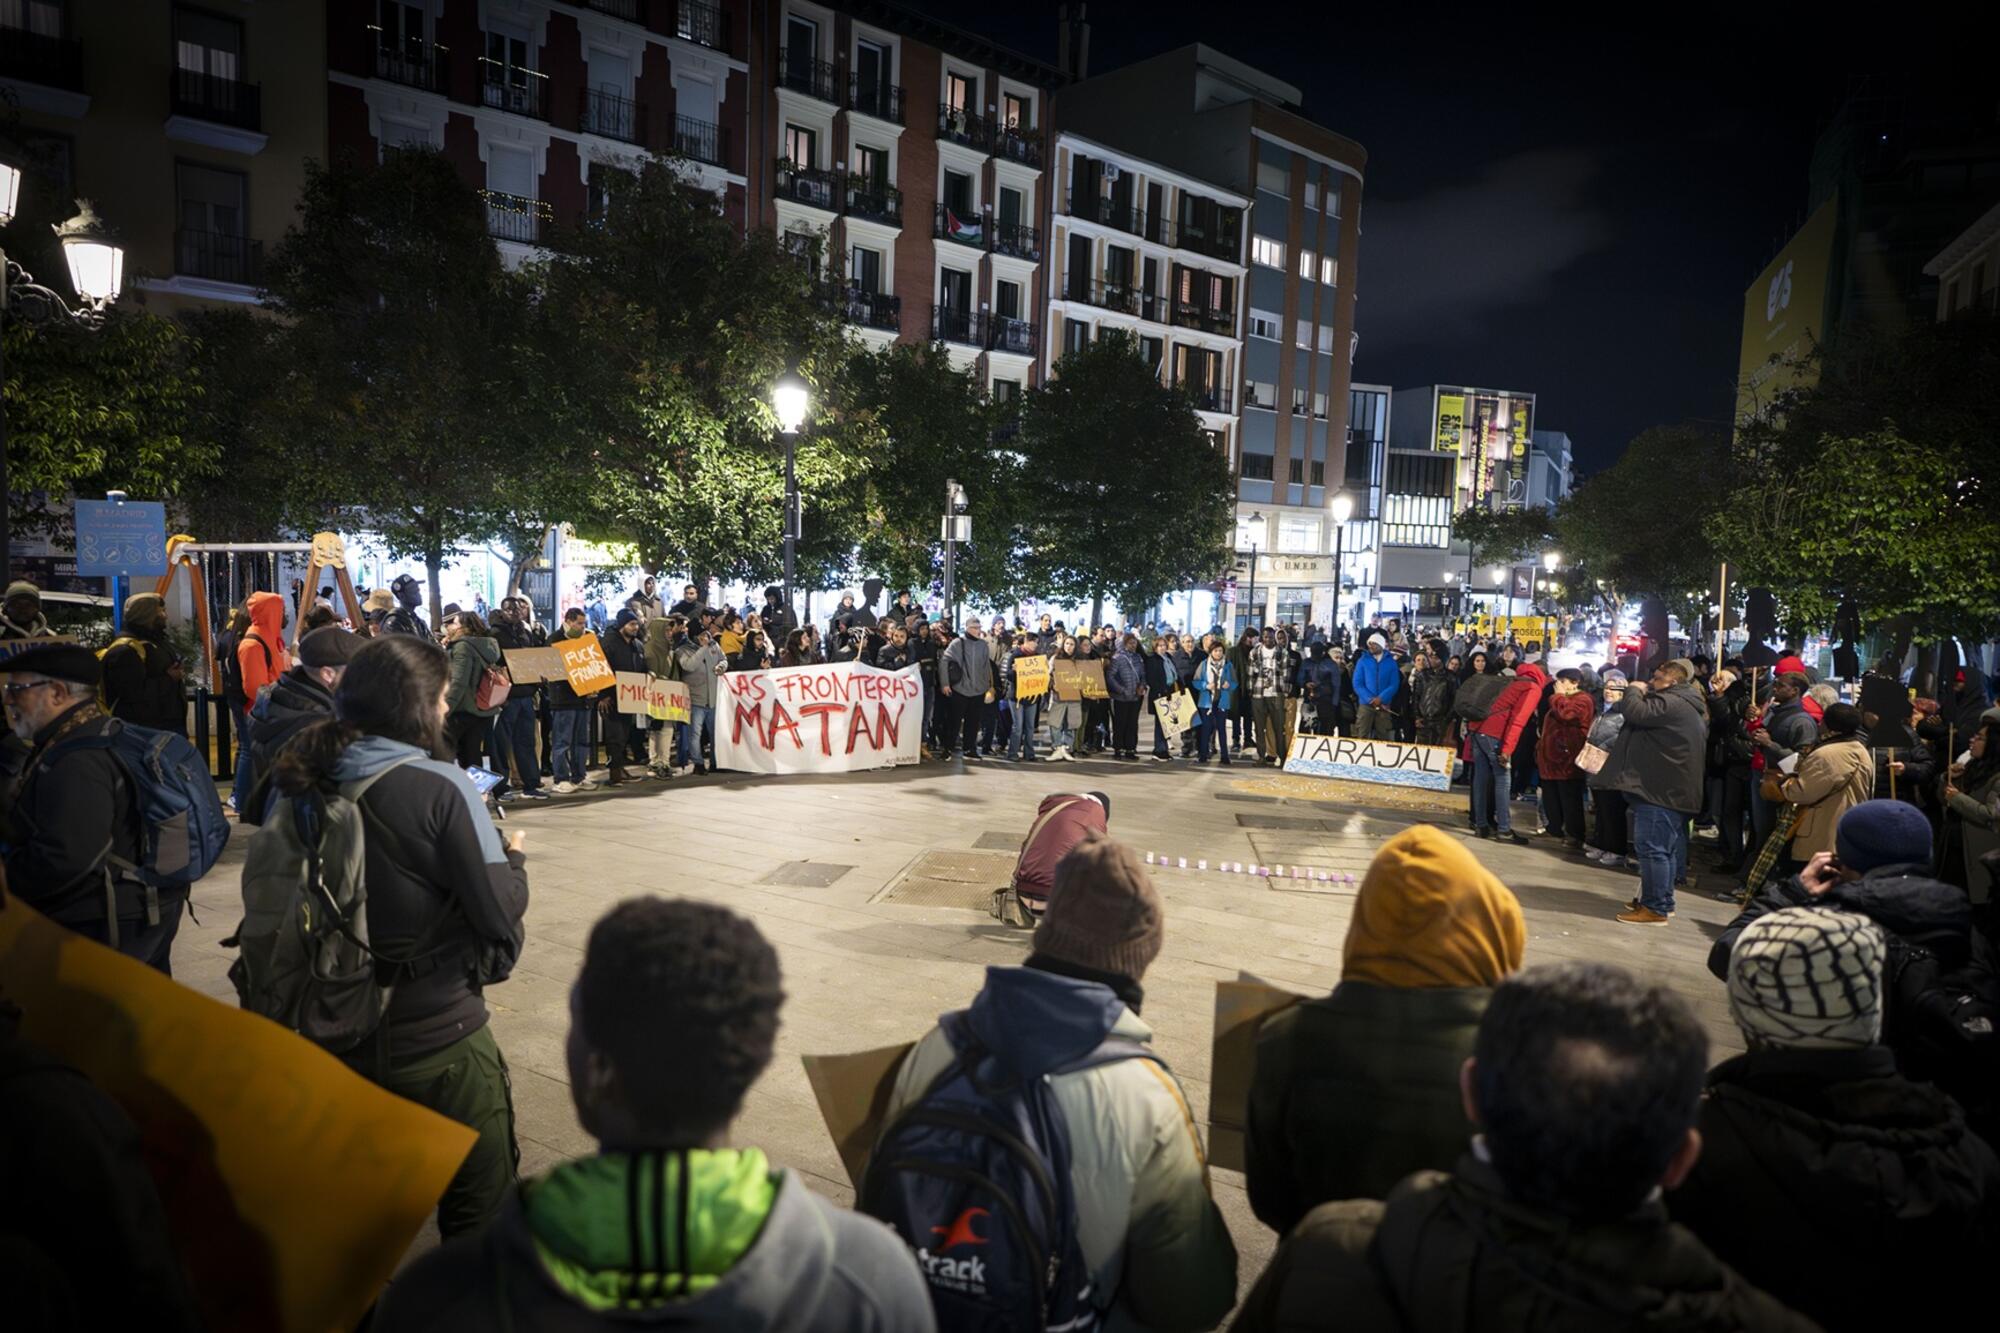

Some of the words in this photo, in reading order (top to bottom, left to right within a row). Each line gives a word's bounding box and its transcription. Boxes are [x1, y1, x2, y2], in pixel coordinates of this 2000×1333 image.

[564, 643, 601, 667] FUCK
[724, 673, 767, 701] LAS
[776, 671, 920, 702] FRONTERAS
[732, 698, 906, 757] MATAN
[1297, 735, 1440, 774] TARAJAL
